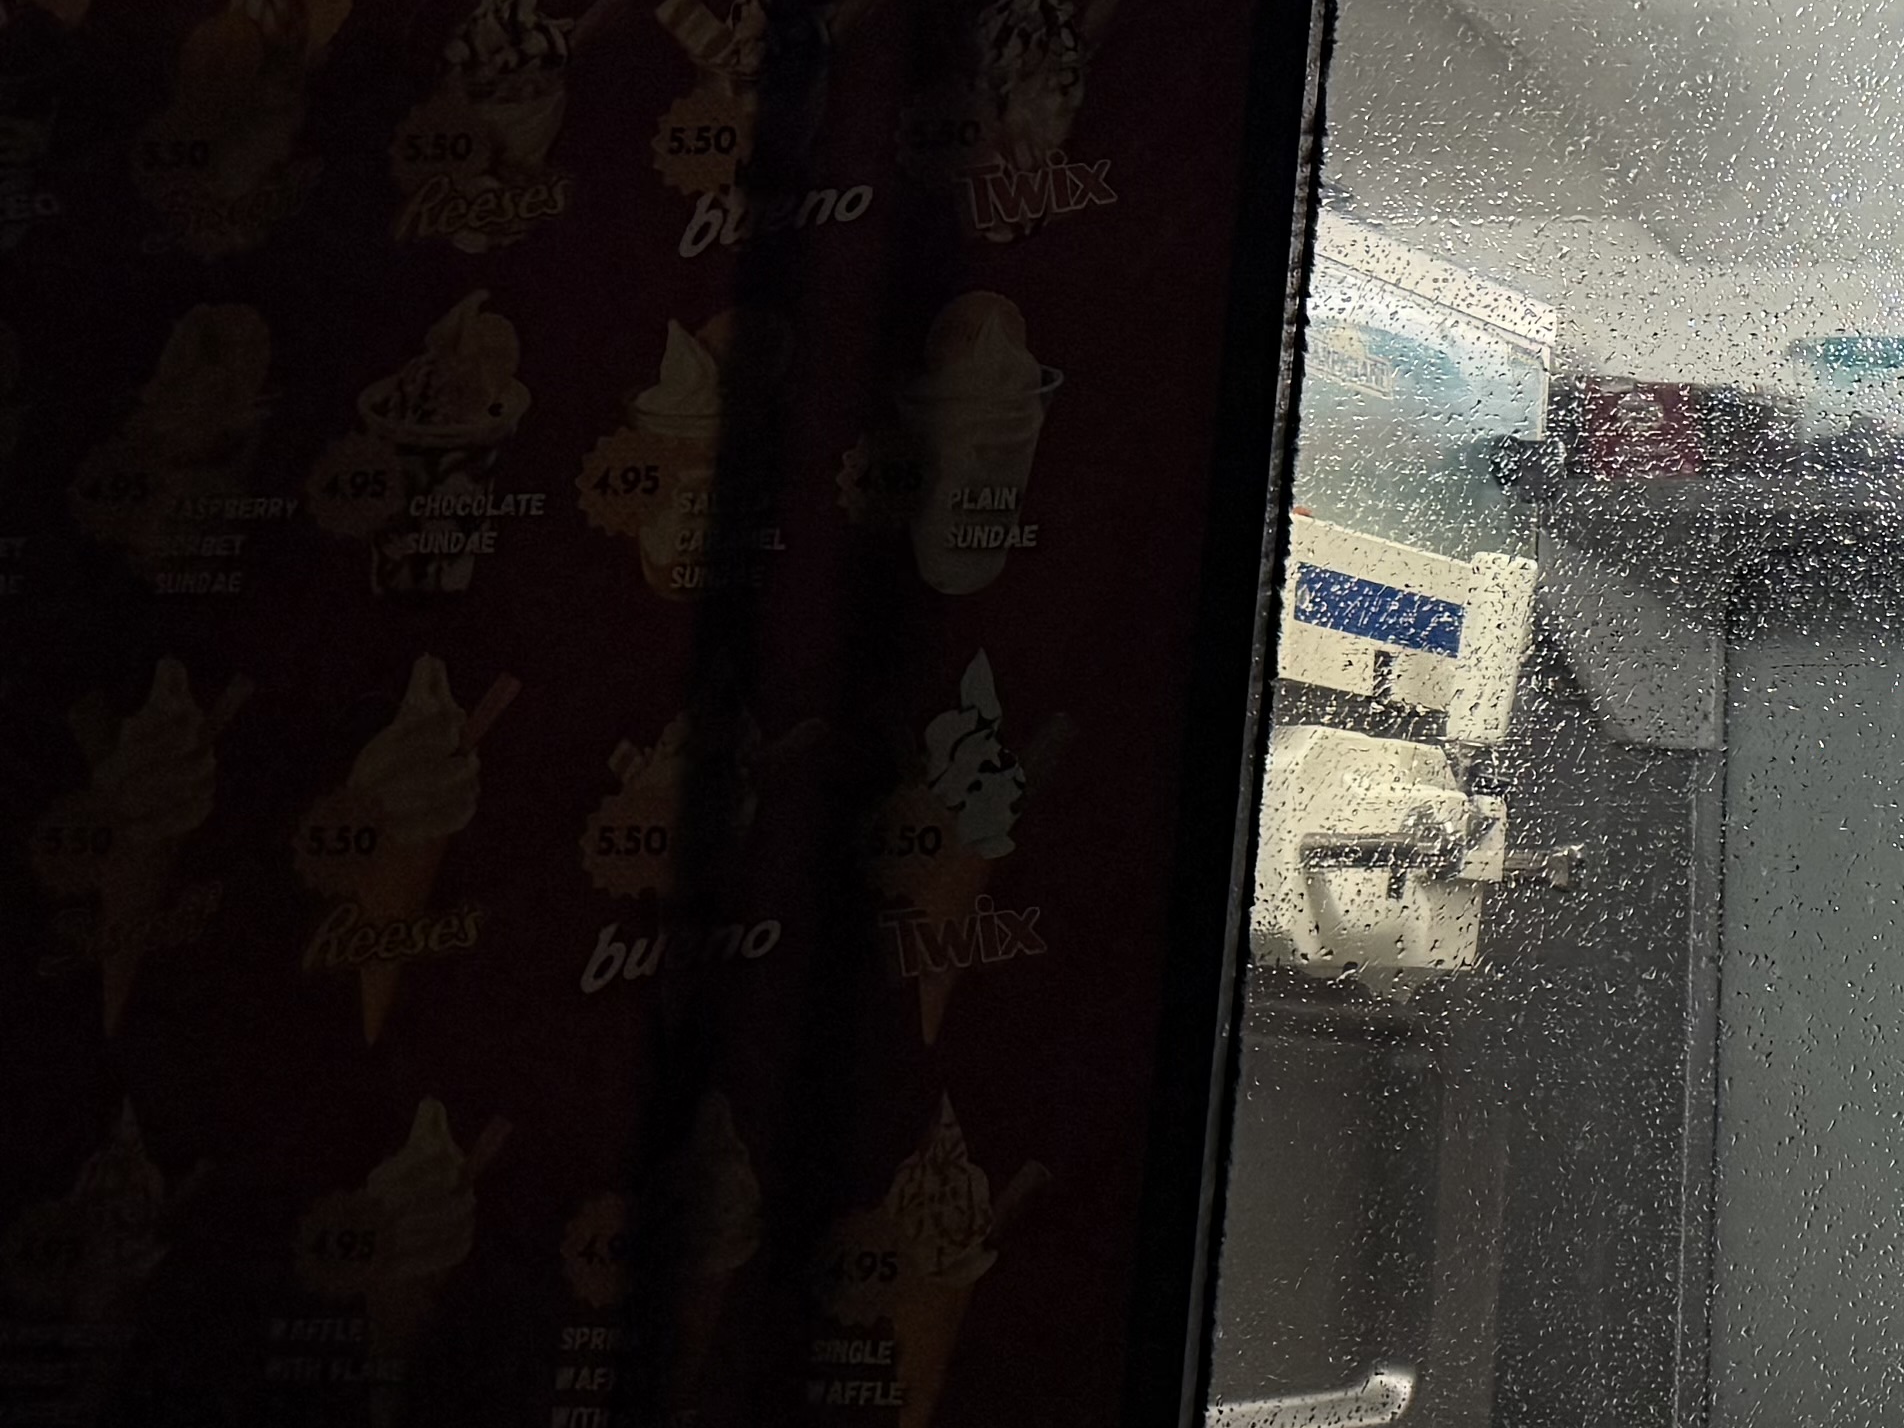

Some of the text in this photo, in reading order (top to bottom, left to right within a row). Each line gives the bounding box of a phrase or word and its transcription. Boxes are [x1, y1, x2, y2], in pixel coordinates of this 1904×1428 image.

[404, 134, 473, 163] 5.50
[667, 126, 737, 156] 5.50
[677, 184, 875, 260] buno
[592, 466, 661, 496] 4.95
[408, 493, 547, 518] CHOCOLATE
[947, 486, 1020, 512] PLAIN
[403, 530, 498, 556] SUNDAE
[674, 527, 788, 552] CAEL
[945, 524, 1040, 550] SUNDAE
[306, 825, 378, 856] 5.50
[597, 825, 668, 856] 5.50
[870, 825, 943, 856] 5.50
[304, 901, 485, 972] Reese's
[579, 918, 783, 996] buno
[806, 1378, 905, 1407] WAFFLE
